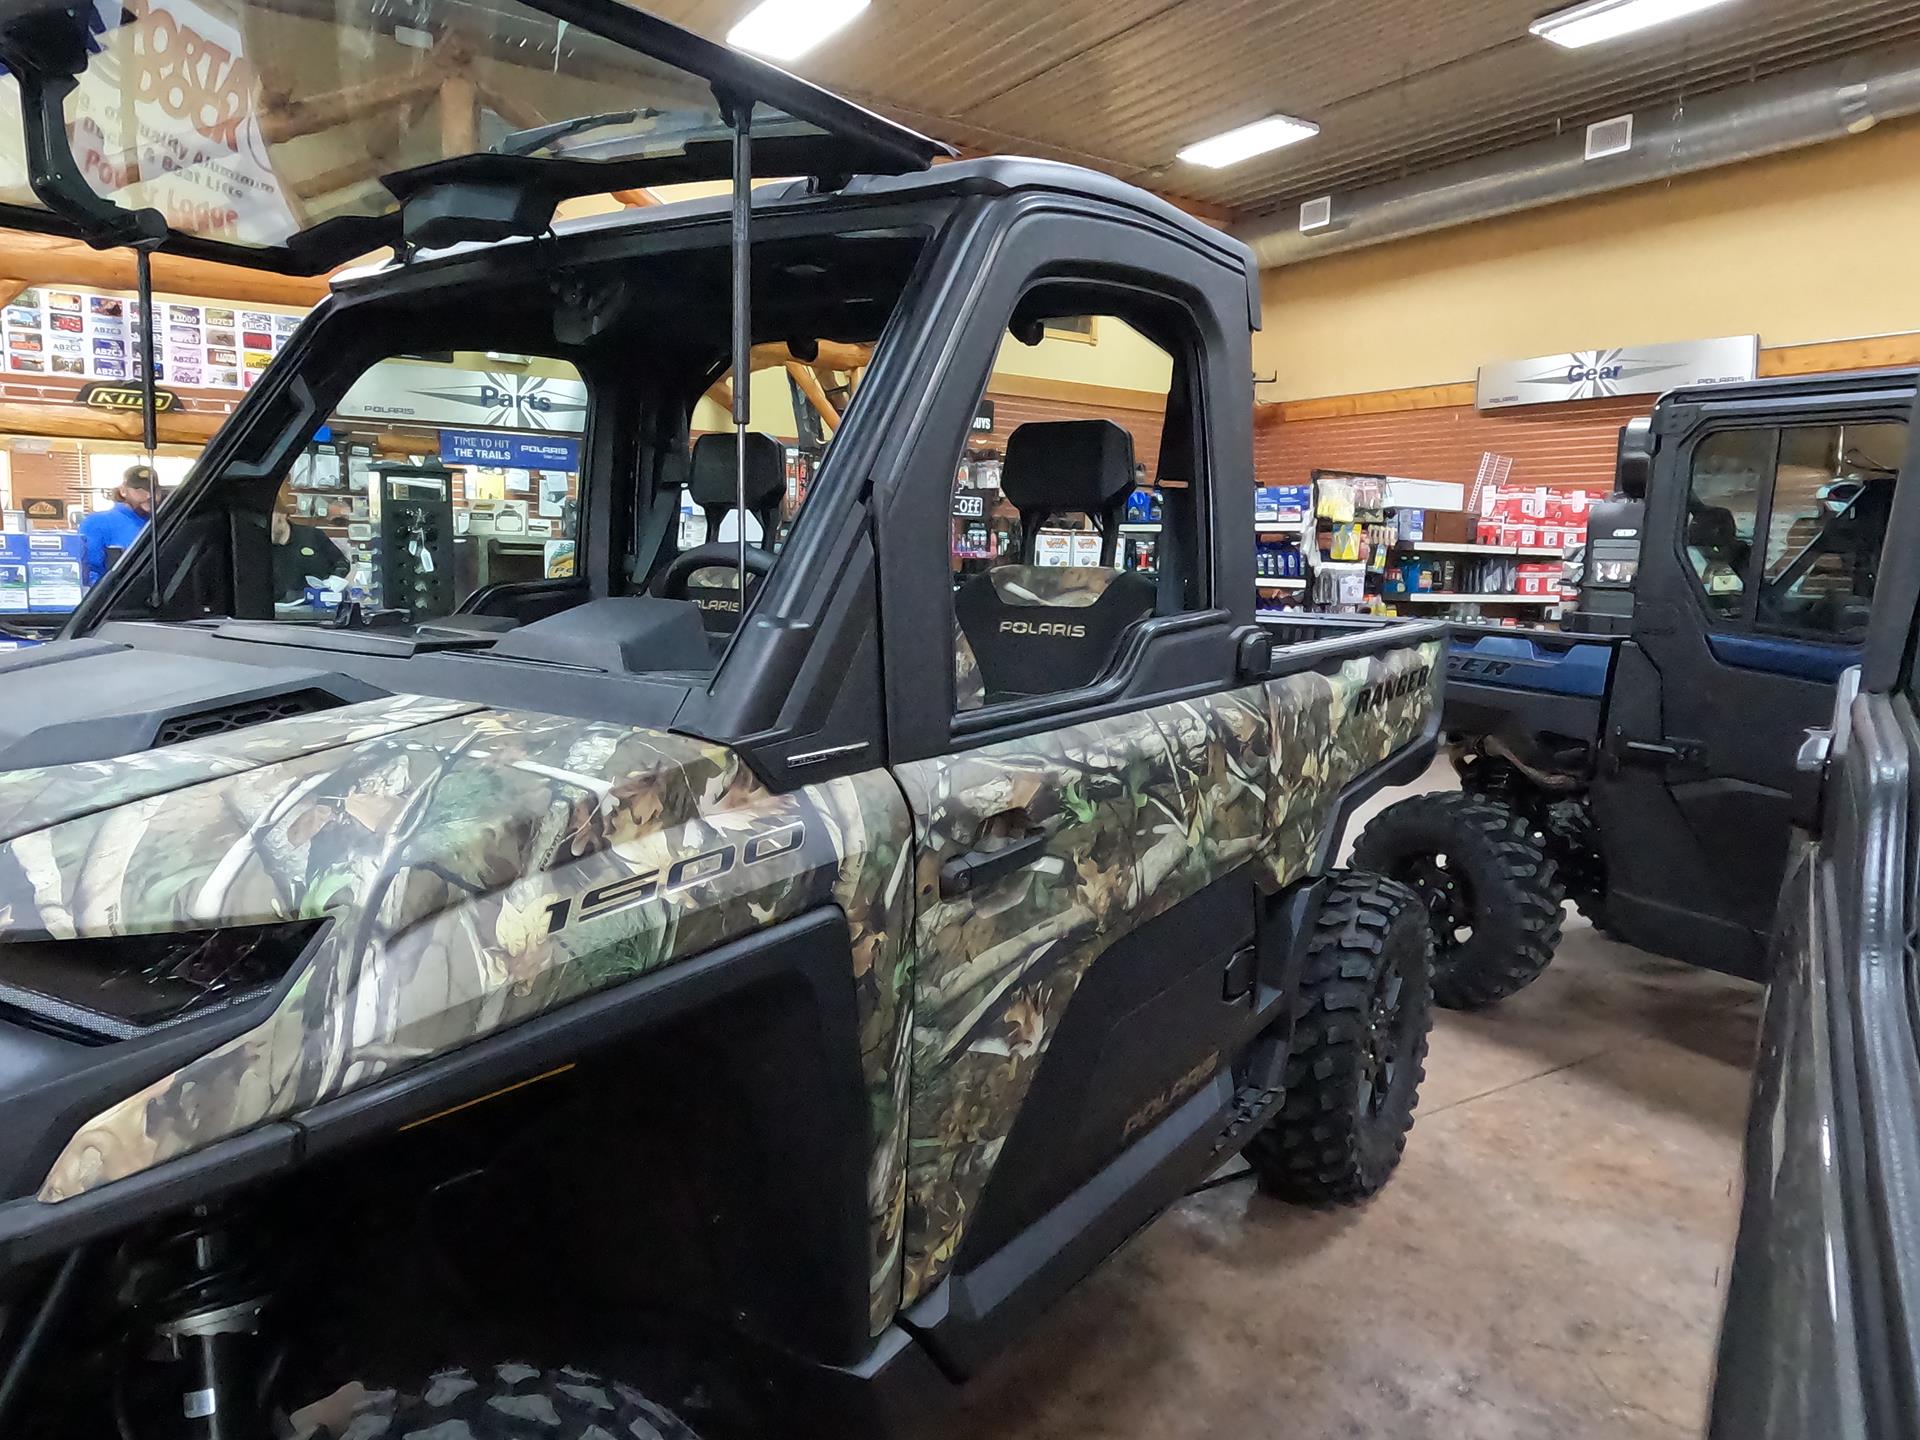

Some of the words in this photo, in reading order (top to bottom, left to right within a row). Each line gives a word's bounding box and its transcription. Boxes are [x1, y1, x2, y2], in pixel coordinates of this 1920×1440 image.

[1568, 363, 1623, 384] Gear
[480, 385, 551, 411] Parts
[364, 405, 415, 415] POLARIS
[973, 417, 991, 429] UYS
[453, 436, 476, 447] TIME
[480, 438, 493, 448] TO
[494, 439, 510, 449] HIT
[520, 444, 568, 455] POLARIS
[454, 447, 474, 458] THE
[475, 449, 511, 460] TRAILS
[999, 621, 1086, 637] POLARIS
[1354, 664, 1430, 717] RANGER
[545, 820, 806, 935] 1500
